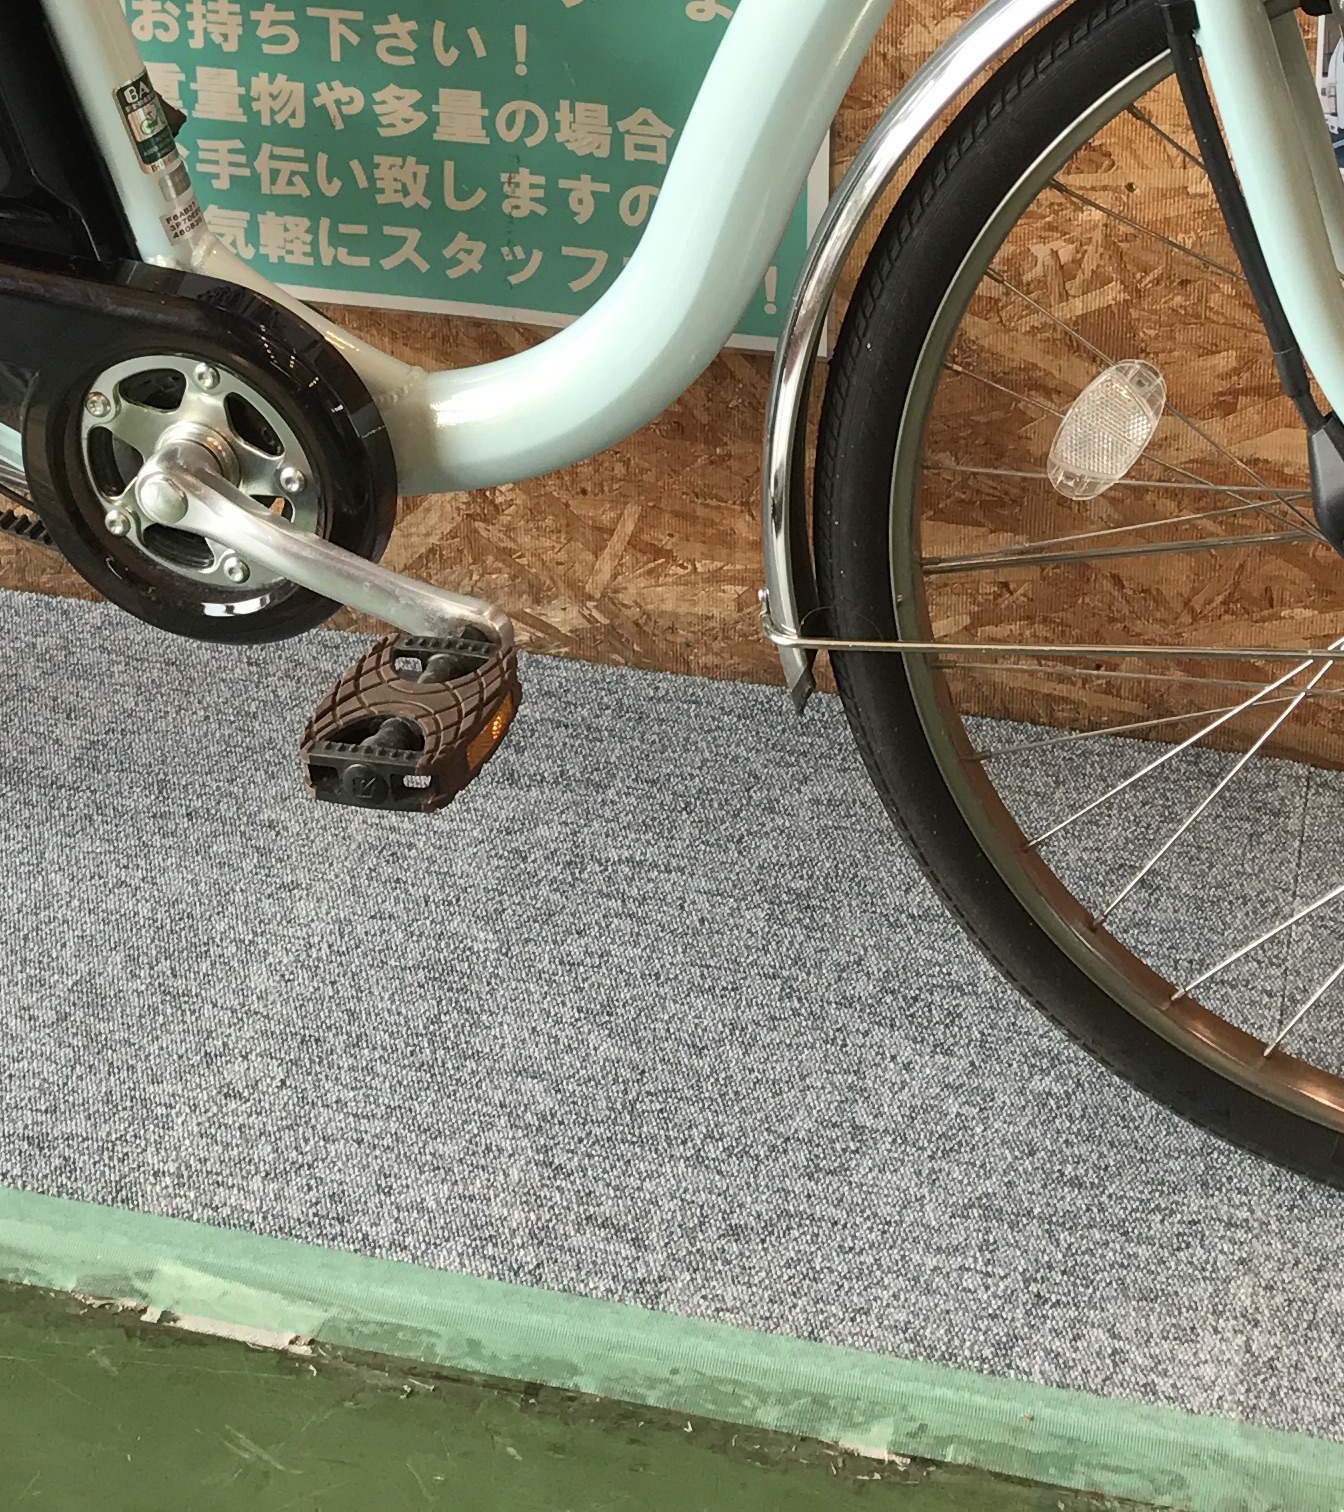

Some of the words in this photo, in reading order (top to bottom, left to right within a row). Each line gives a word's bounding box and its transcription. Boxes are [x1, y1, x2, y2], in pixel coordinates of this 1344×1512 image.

[175, 137, 658, 229] 手伝い致しますの
